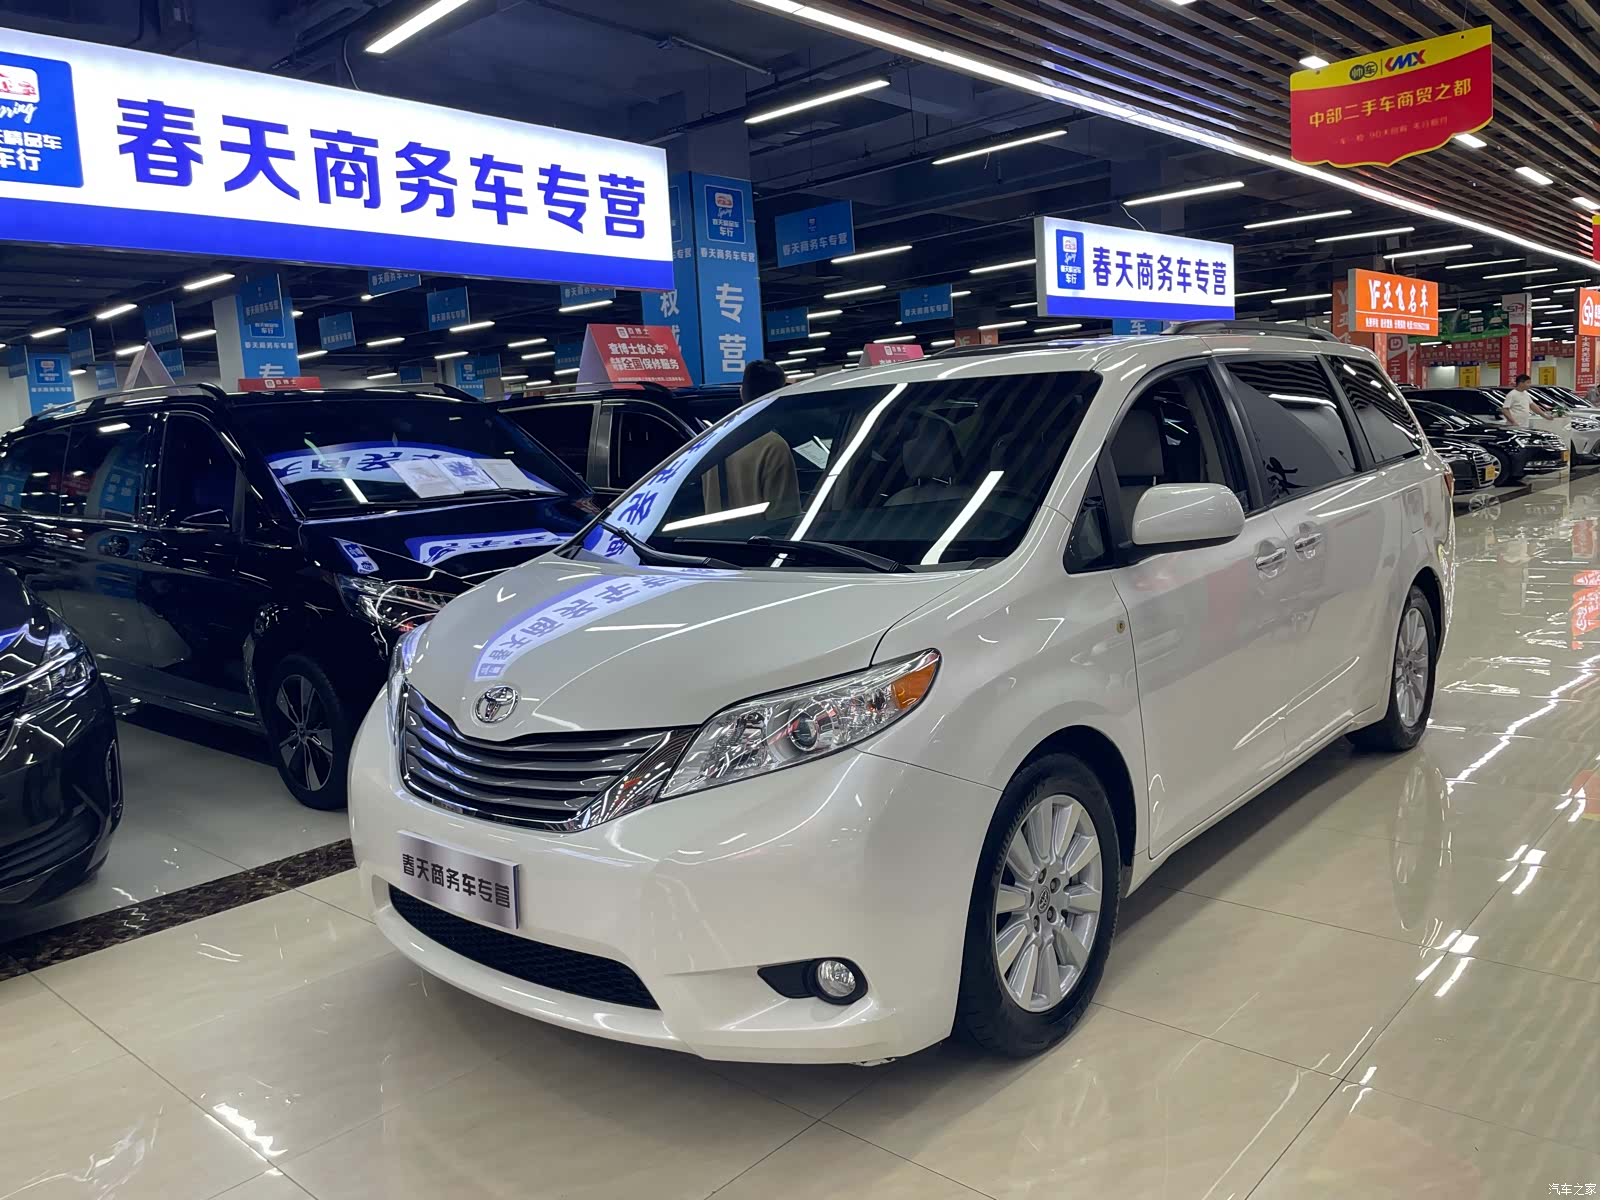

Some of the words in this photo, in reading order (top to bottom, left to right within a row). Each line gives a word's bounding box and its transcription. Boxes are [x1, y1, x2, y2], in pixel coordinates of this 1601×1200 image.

[1309, 78, 1472, 128] 中部二手车商贸之都
[116, 98, 646, 239] 春天商务车专营
[700, 247, 756, 263] 春天商务车专营
[720, 227, 734, 237] 车行
[782, 232, 849, 257] 春天商务车专营
[1093, 246, 1227, 296] 春天商务车专营
[715, 283, 747, 374] 专营
[402, 853, 511, 909] 春天商务车专营
